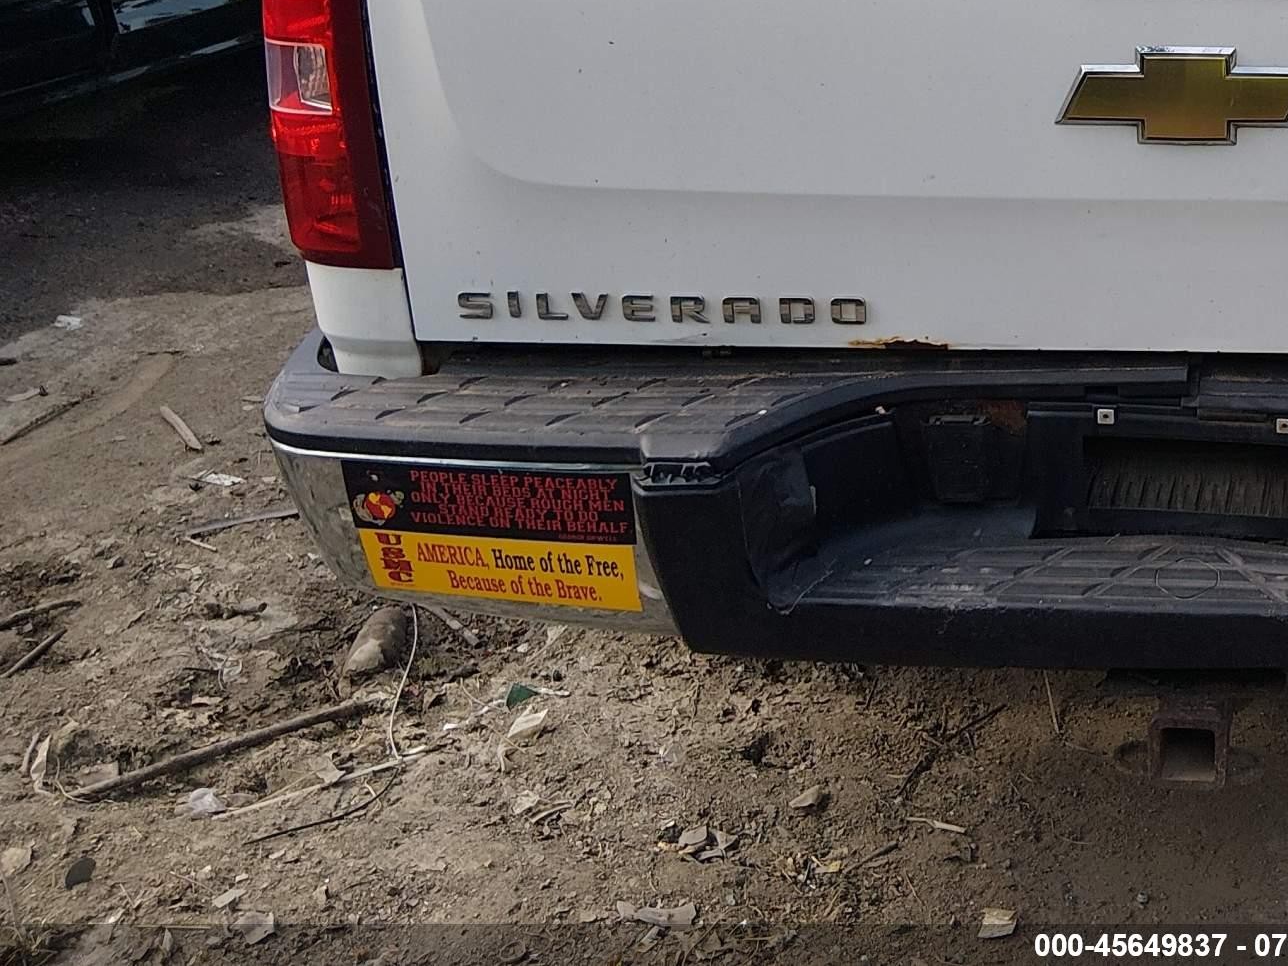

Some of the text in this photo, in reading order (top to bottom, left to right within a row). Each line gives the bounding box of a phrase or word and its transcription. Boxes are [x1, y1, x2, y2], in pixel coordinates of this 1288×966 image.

[456, 290, 868, 325] SILVERADO
[410, 470, 617, 490] PEOPLE SLEEP PEACEABLY
[420, 481, 610, 501] IN THEIR BEDS AT NIGHT
[410, 491, 625, 512] ONLY BECAUSE ROUGH MEN
[439, 503, 599, 522] STAND READY TO DO
[410, 511, 629, 534] VIOLENCE ON THEIR BEHALF
[375, 532, 415, 583] USMC
[417, 542, 624, 581] AMERICA, Home of the Free,
[447, 570, 602, 601] Because of the Brave.
